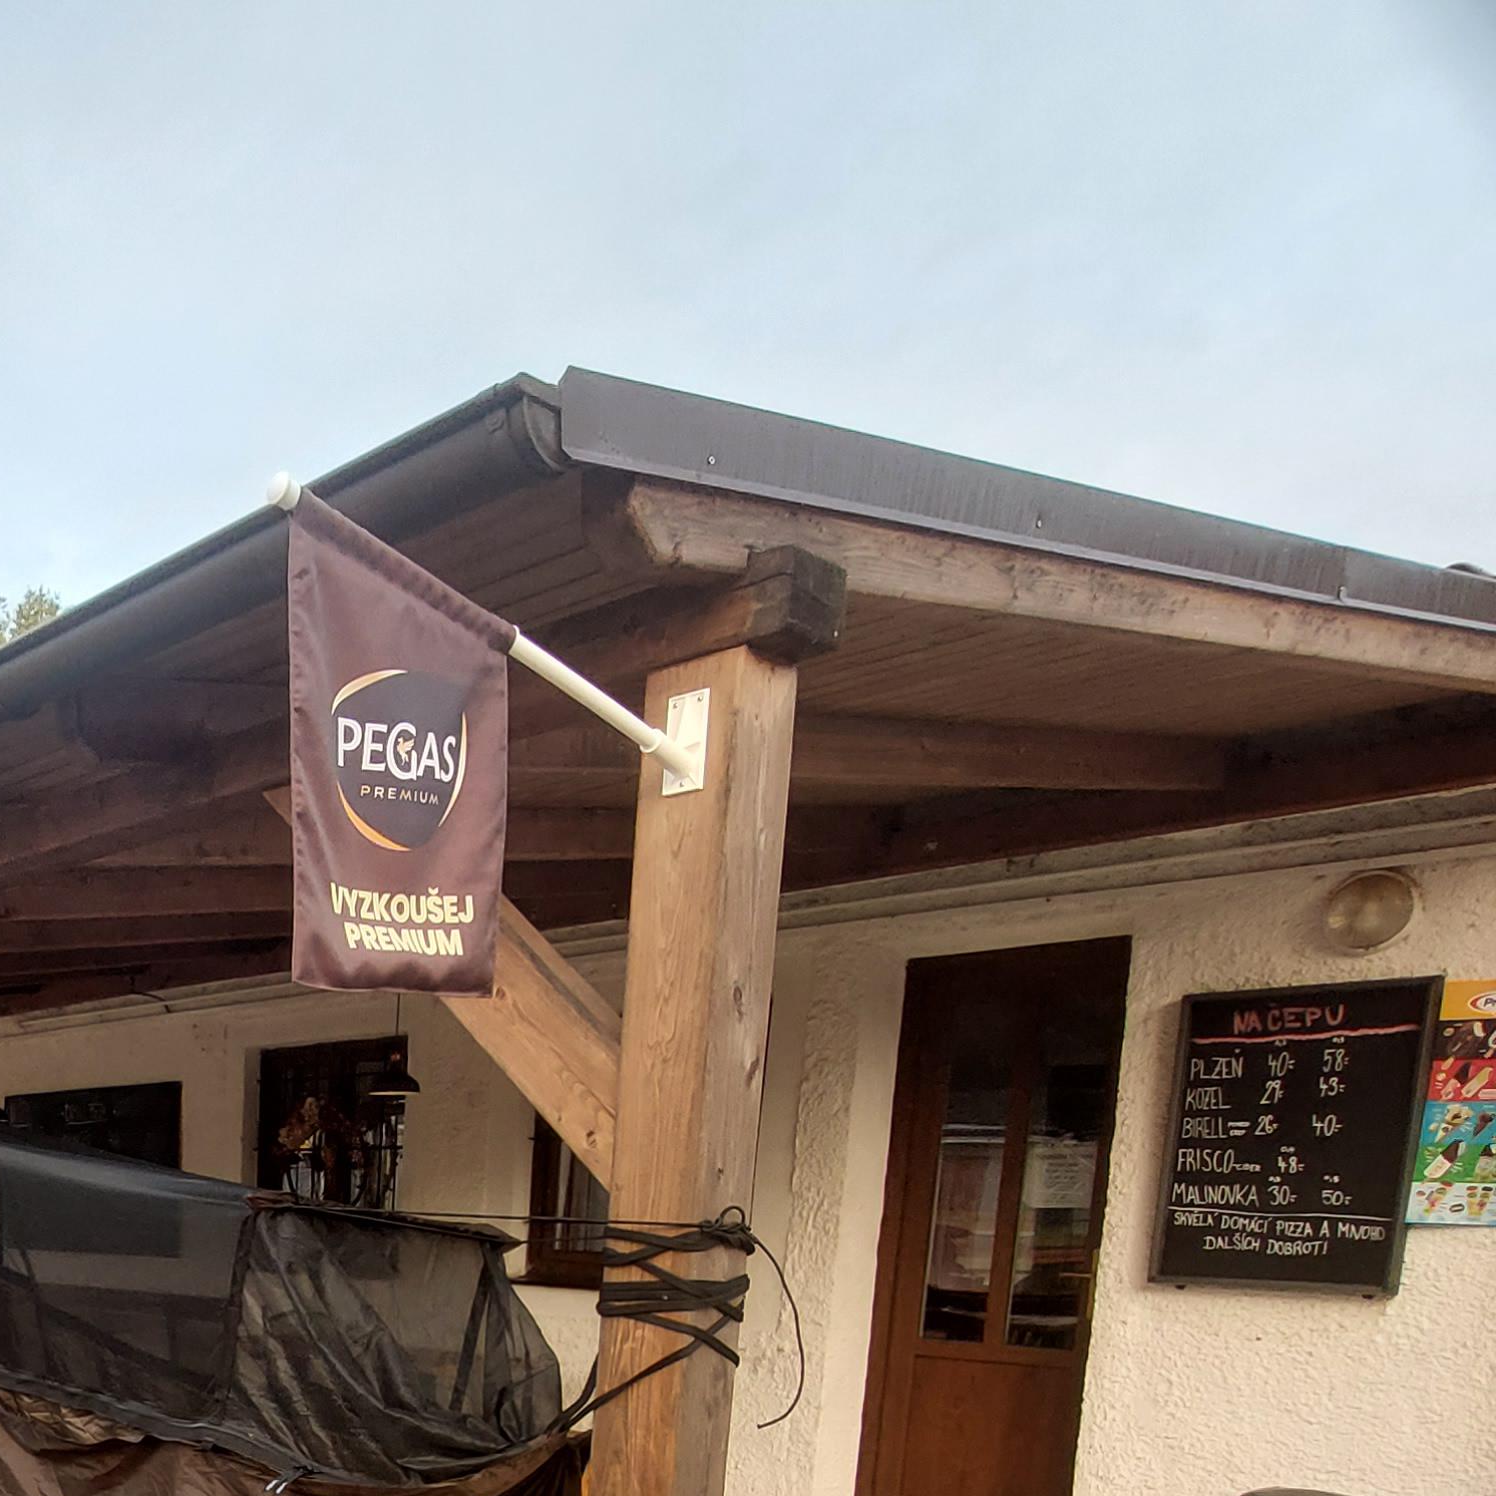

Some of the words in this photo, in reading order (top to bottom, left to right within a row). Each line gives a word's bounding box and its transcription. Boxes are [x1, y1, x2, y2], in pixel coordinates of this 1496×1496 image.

[337, 716, 456, 782] PEGAS
[360, 785, 439, 805] PREMIUM
[330, 882, 474, 924] VYZKOUŠEJ
[344, 922, 464, 956] PREMIUM
[1233, 1010, 1262, 1034] NA
[1190, 1048, 1244, 1080] PLZEŇ
[1185, 1087, 1232, 1111] KOZEL
[1177, 1148, 1235, 1174] FRISCO
[1171, 1182, 1260, 1208] MALINOVKA
[1221, 1215, 1272, 1233] DOMÁCÍ
[1276, 1220, 1313, 1238] PIZZA
[1319, 1220, 1330, 1238] A
